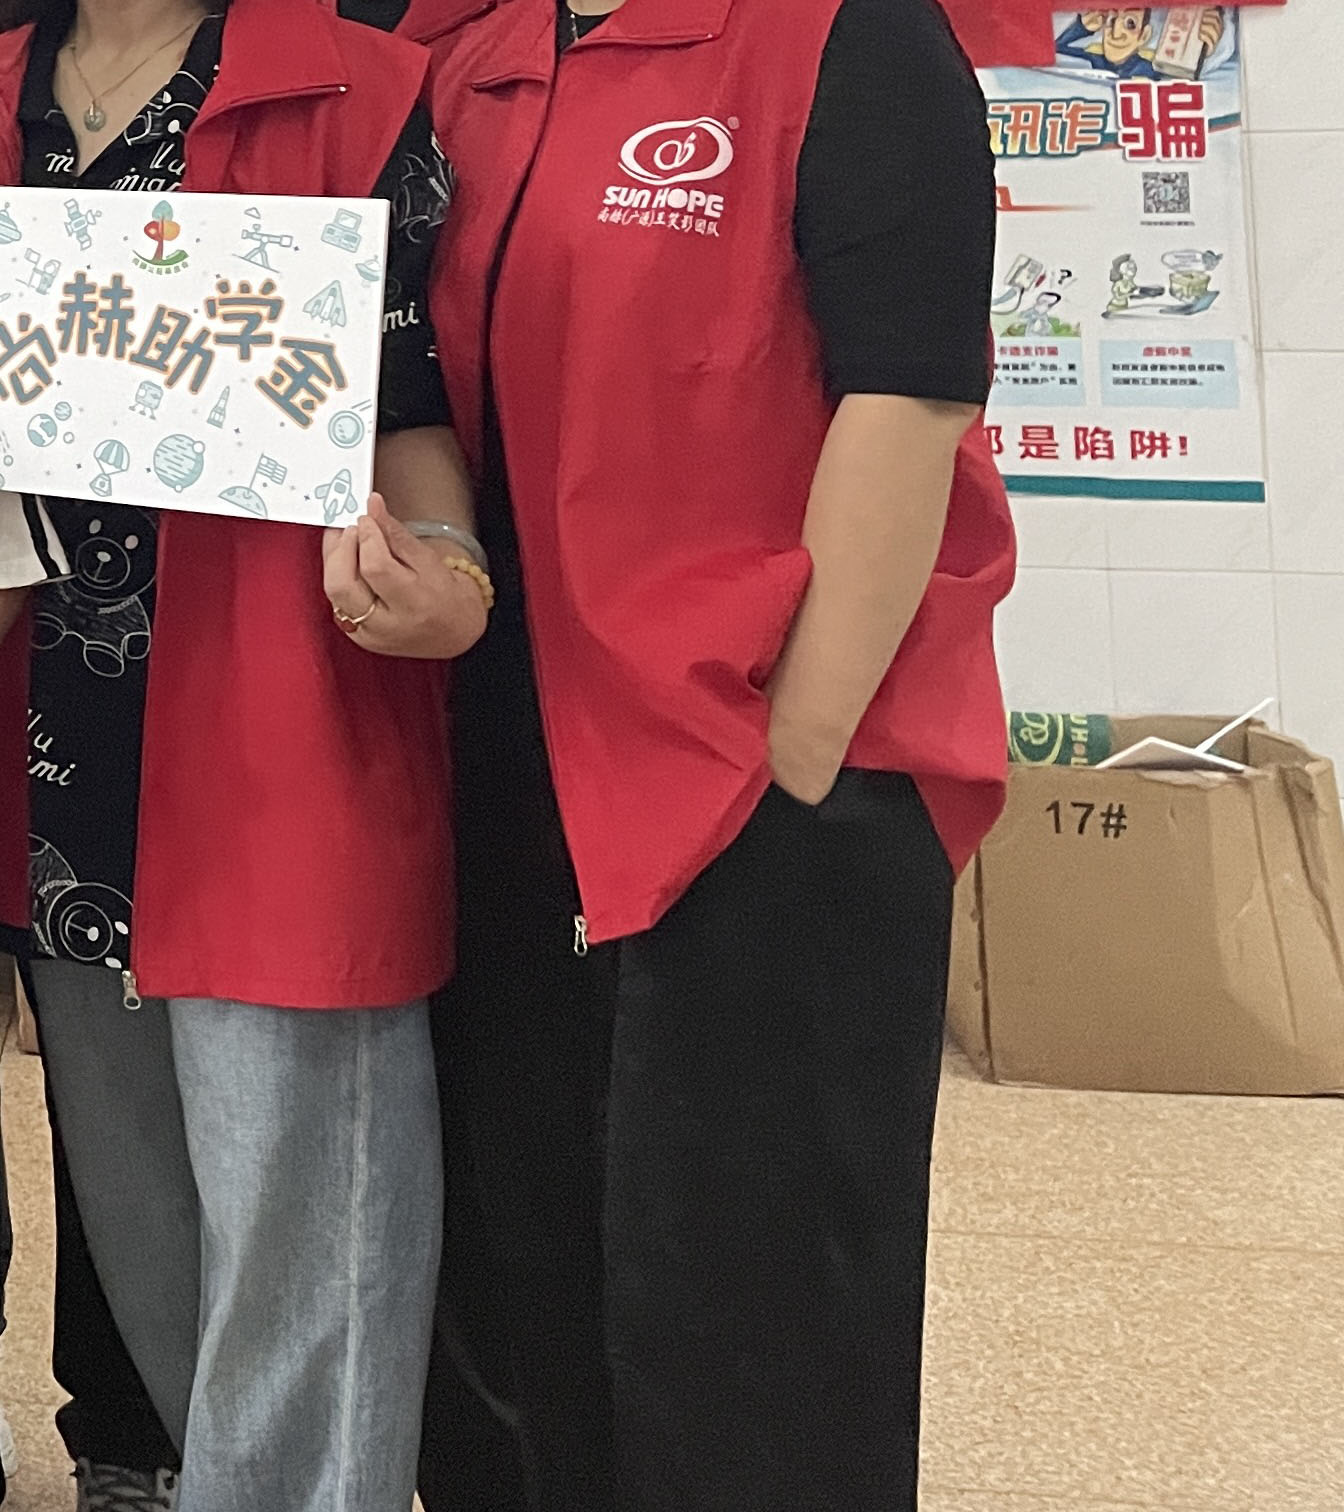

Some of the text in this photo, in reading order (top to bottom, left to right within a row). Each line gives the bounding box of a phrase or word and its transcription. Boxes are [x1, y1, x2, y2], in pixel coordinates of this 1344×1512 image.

[602, 185, 724, 218] SUN HOPE
[1045, 798, 1129, 841] 17#
